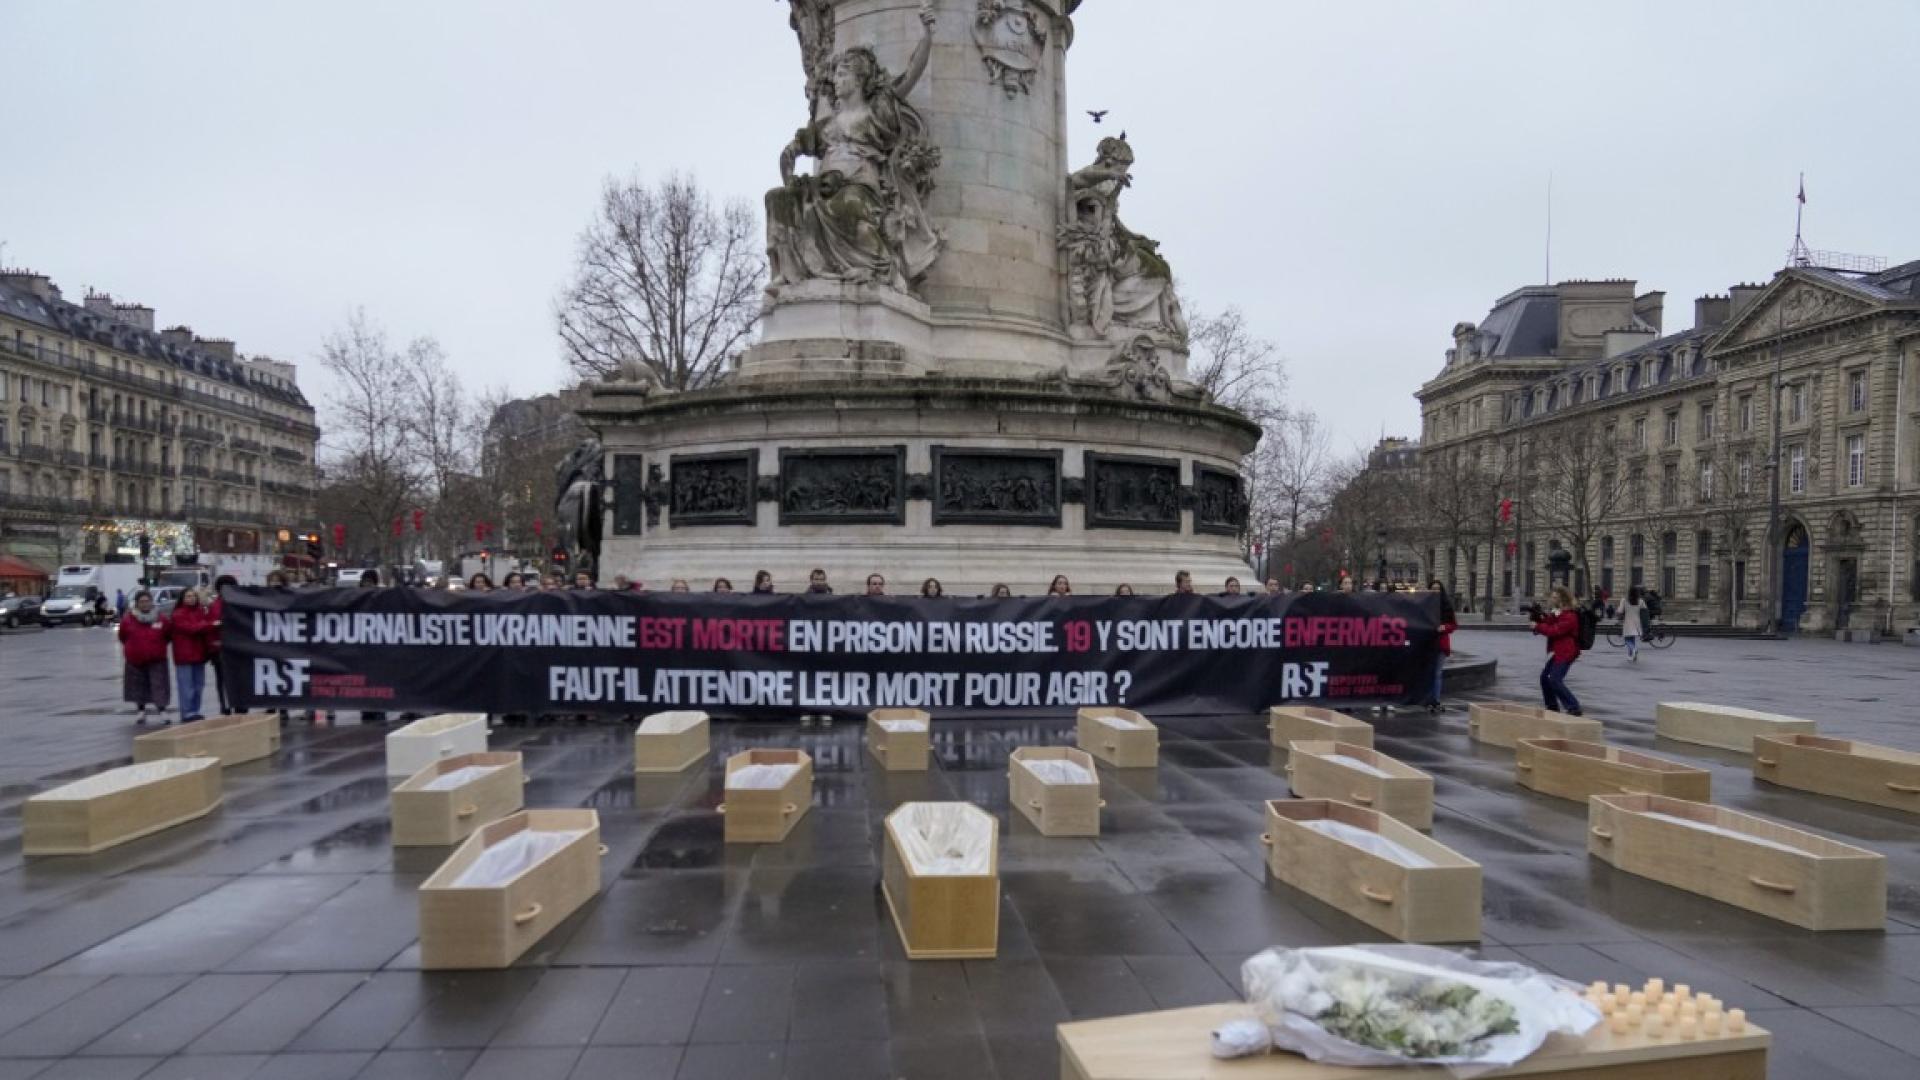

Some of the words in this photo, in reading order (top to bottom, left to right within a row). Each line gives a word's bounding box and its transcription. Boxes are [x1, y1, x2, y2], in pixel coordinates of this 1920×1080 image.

[253, 612, 307, 644] UNE
[312, 613, 471, 646] JOURNALISTE
[474, 614, 636, 647] UKRAINIENNE
[640, 617, 686, 648] EST
[692, 618, 784, 652] MORTE
[789, 620, 823, 652] EN
[827, 620, 923, 653] PRISON
[927, 621, 961, 653] EN
[965, 621, 1059, 654] RUSSIE.
[1063, 620, 1092, 652] 19
[1095, 620, 1113, 651] Y
[1116, 618, 1184, 651] SONT
[1187, 618, 1281, 650] ENCORE
[254, 657, 311, 696] RSF
[549, 665, 648, 702] FAUT-IL
[652, 668, 793, 706] ATTENDRE
[799, 671, 870, 706] LEUR
[875, 672, 959, 707] MORT
[964, 672, 1041, 706] POUR
[1045, 671, 1108, 706] AGIR
[1113, 669, 1131, 704] ?
[1281, 661, 1329, 698] RSF
